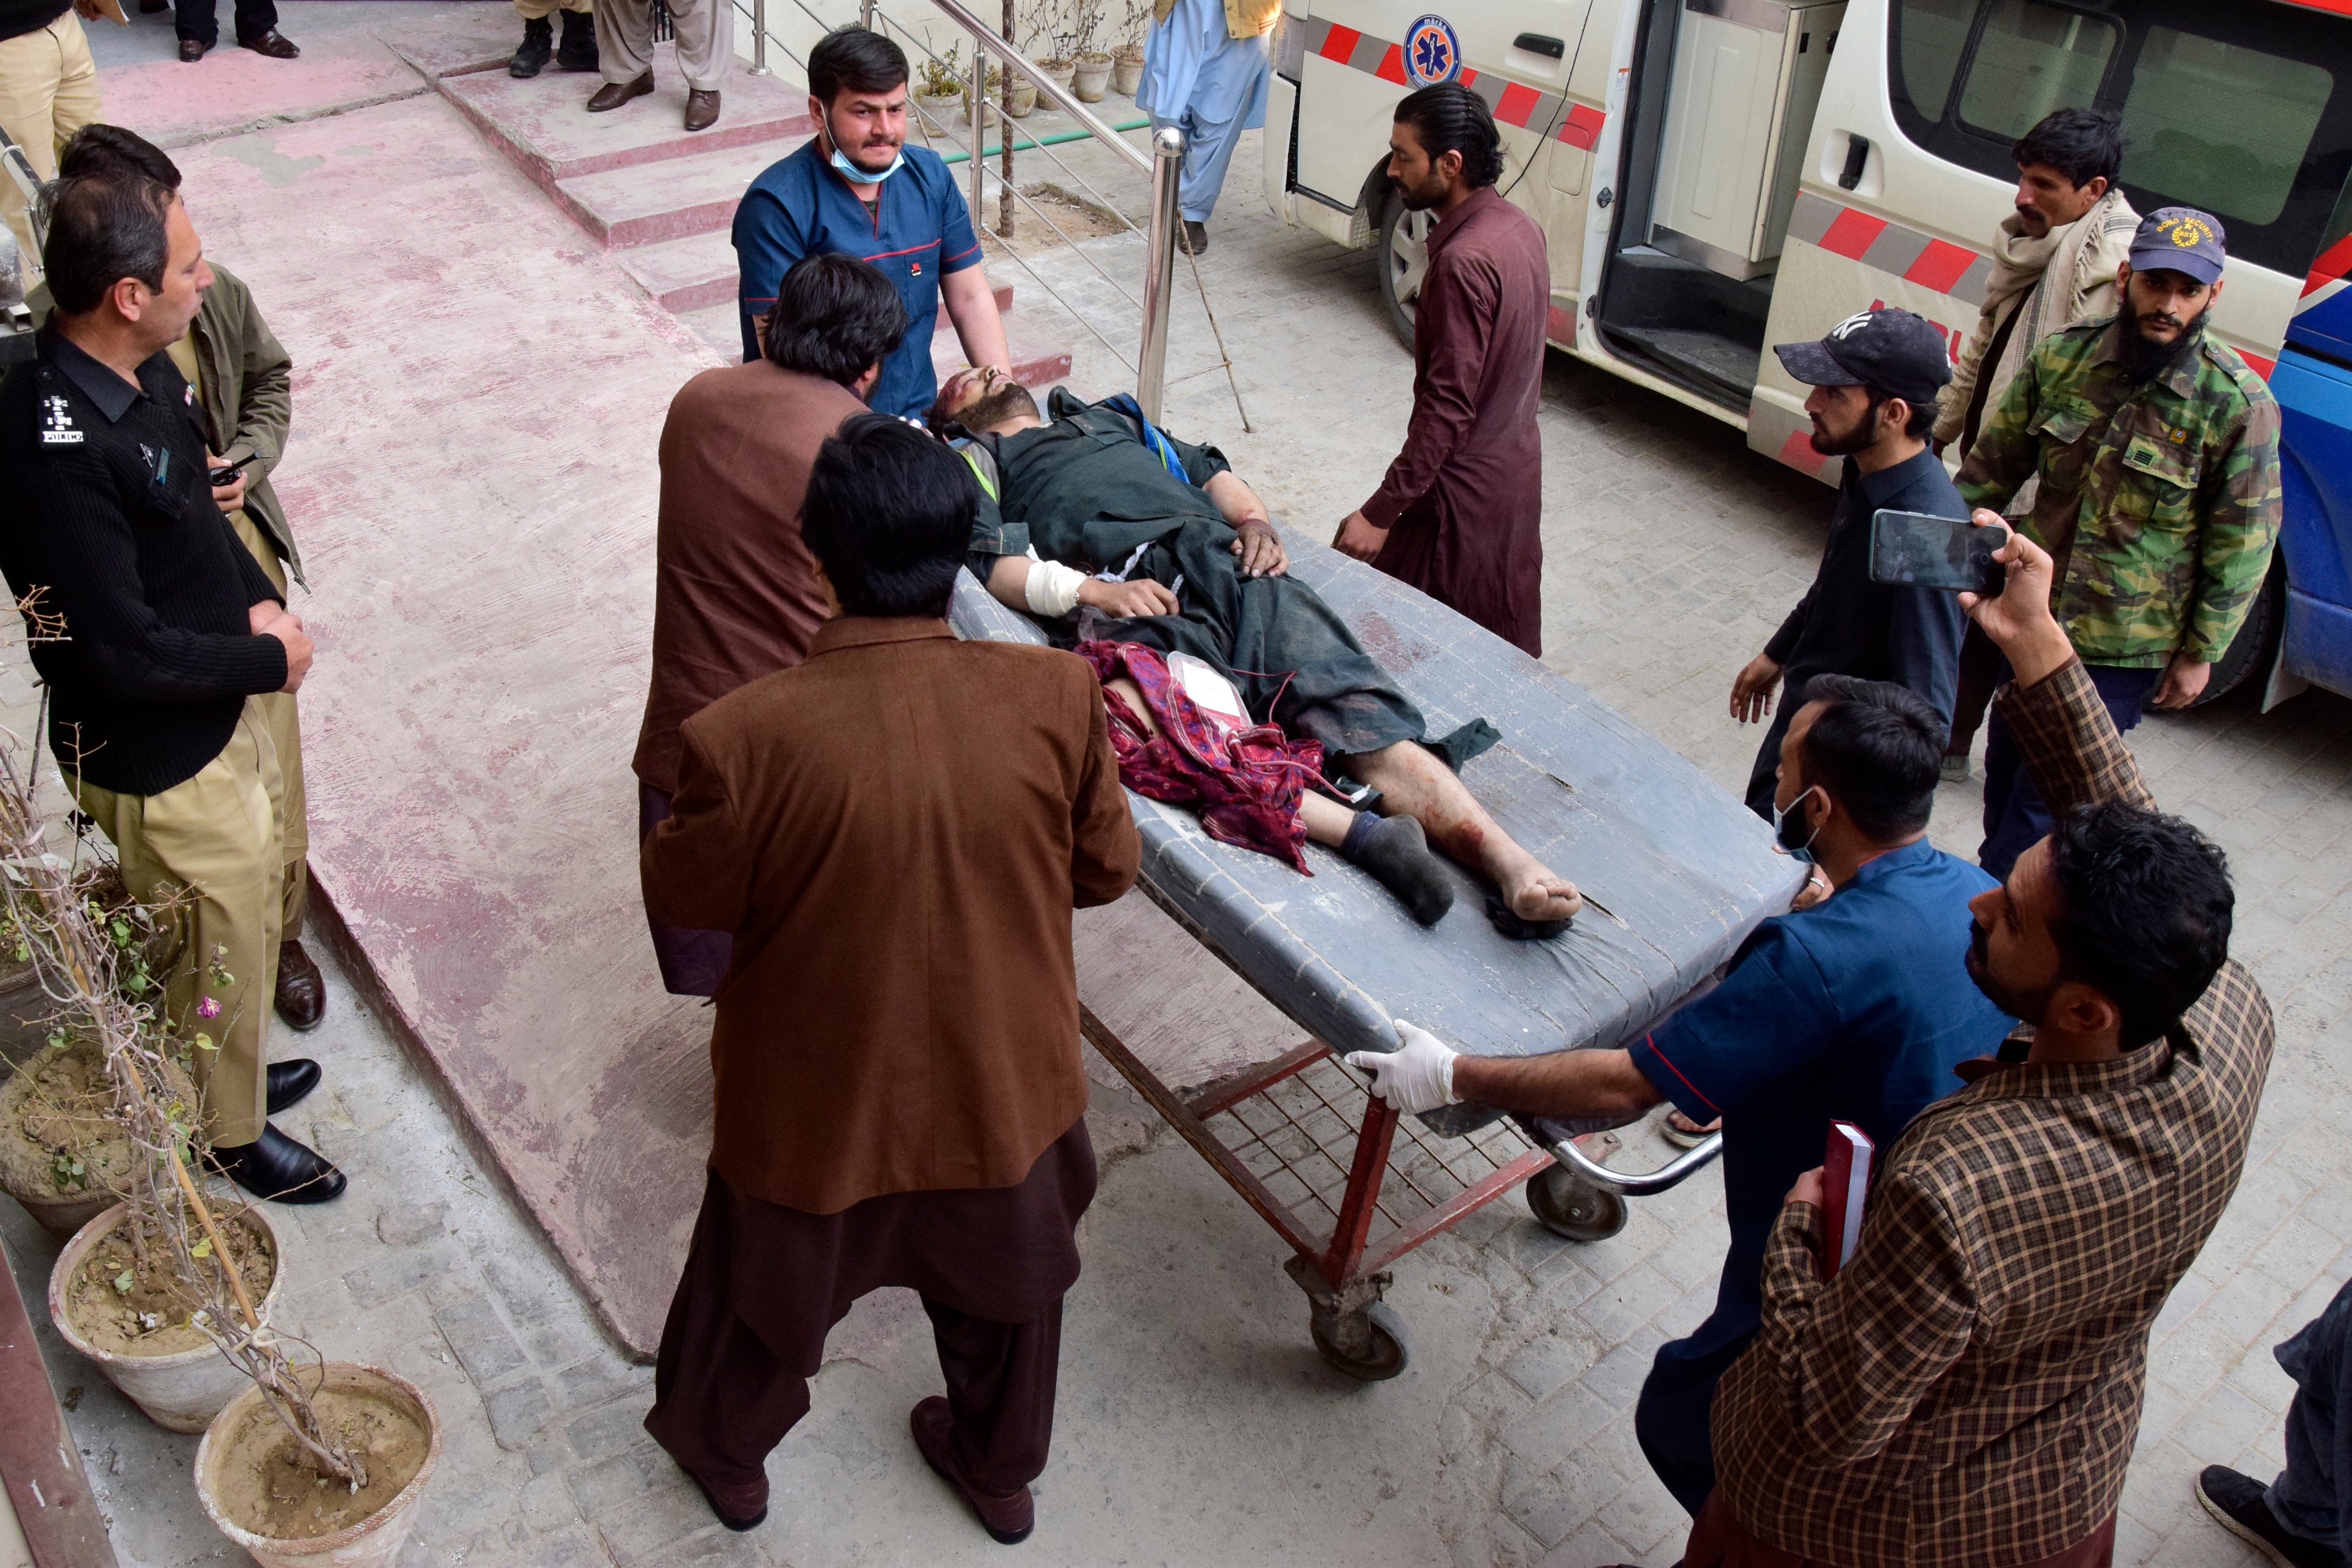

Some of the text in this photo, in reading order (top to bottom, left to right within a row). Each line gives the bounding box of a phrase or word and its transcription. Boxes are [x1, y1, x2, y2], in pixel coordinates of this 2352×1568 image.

[2156, 217, 2214, 243] BOND SECURITY
[44, 430, 84, 443] POLICE
